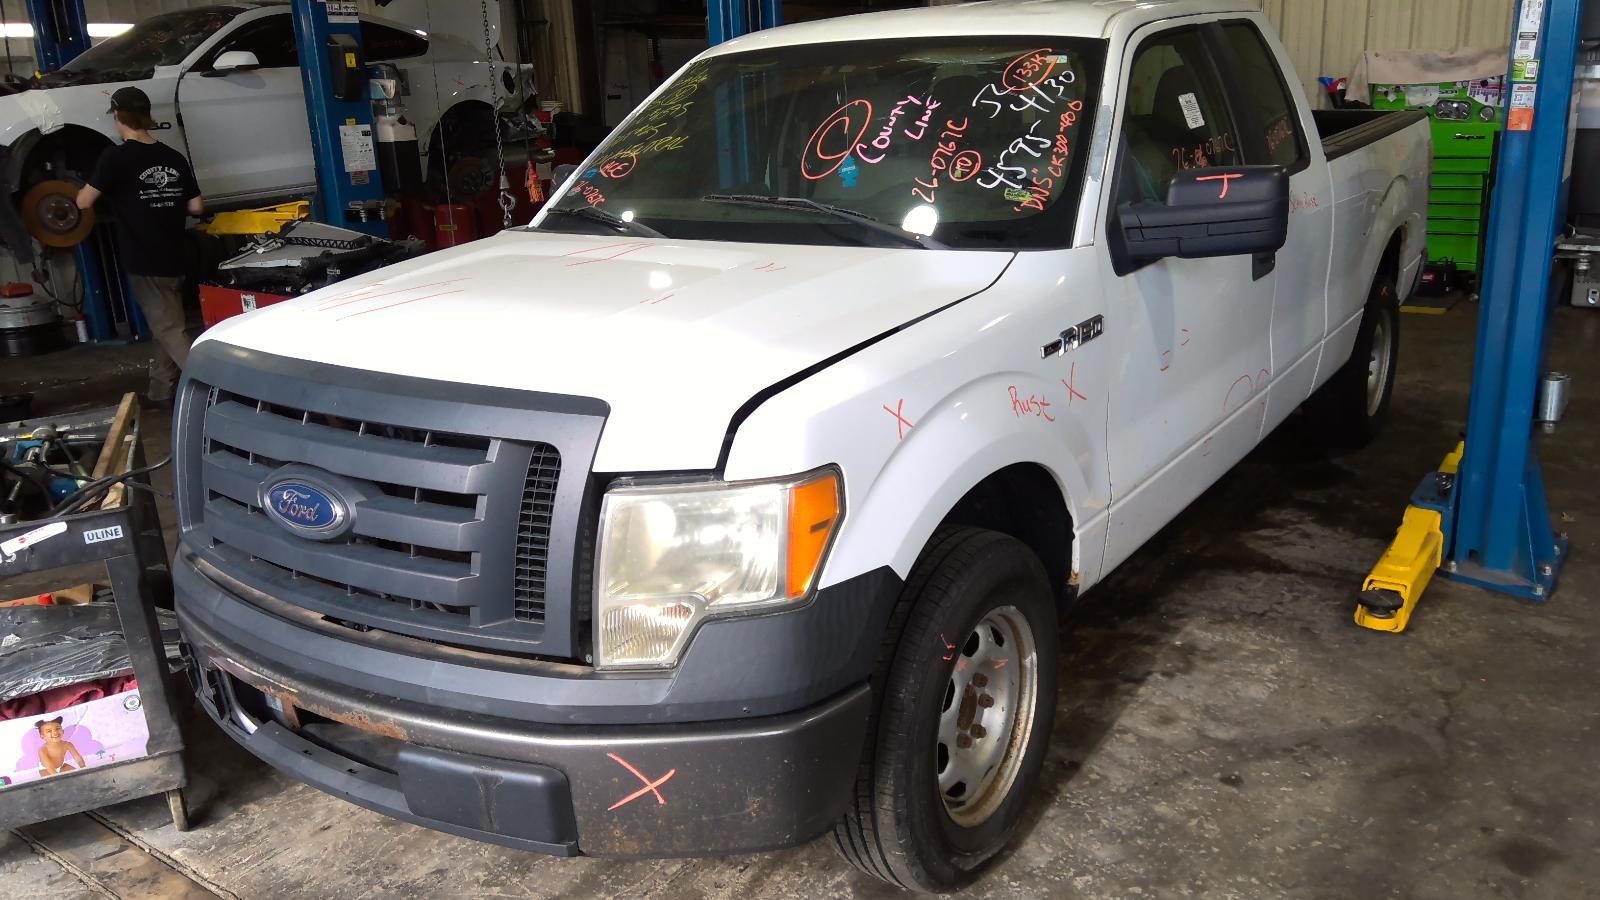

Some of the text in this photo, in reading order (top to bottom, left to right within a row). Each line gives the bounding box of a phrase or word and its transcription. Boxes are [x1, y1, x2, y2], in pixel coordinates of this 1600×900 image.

[856, 95, 922, 164] COUNTY
[904, 95, 943, 140] LINE
[278, 488, 320, 522] Ford
[86, 527, 121, 541] ULINE
